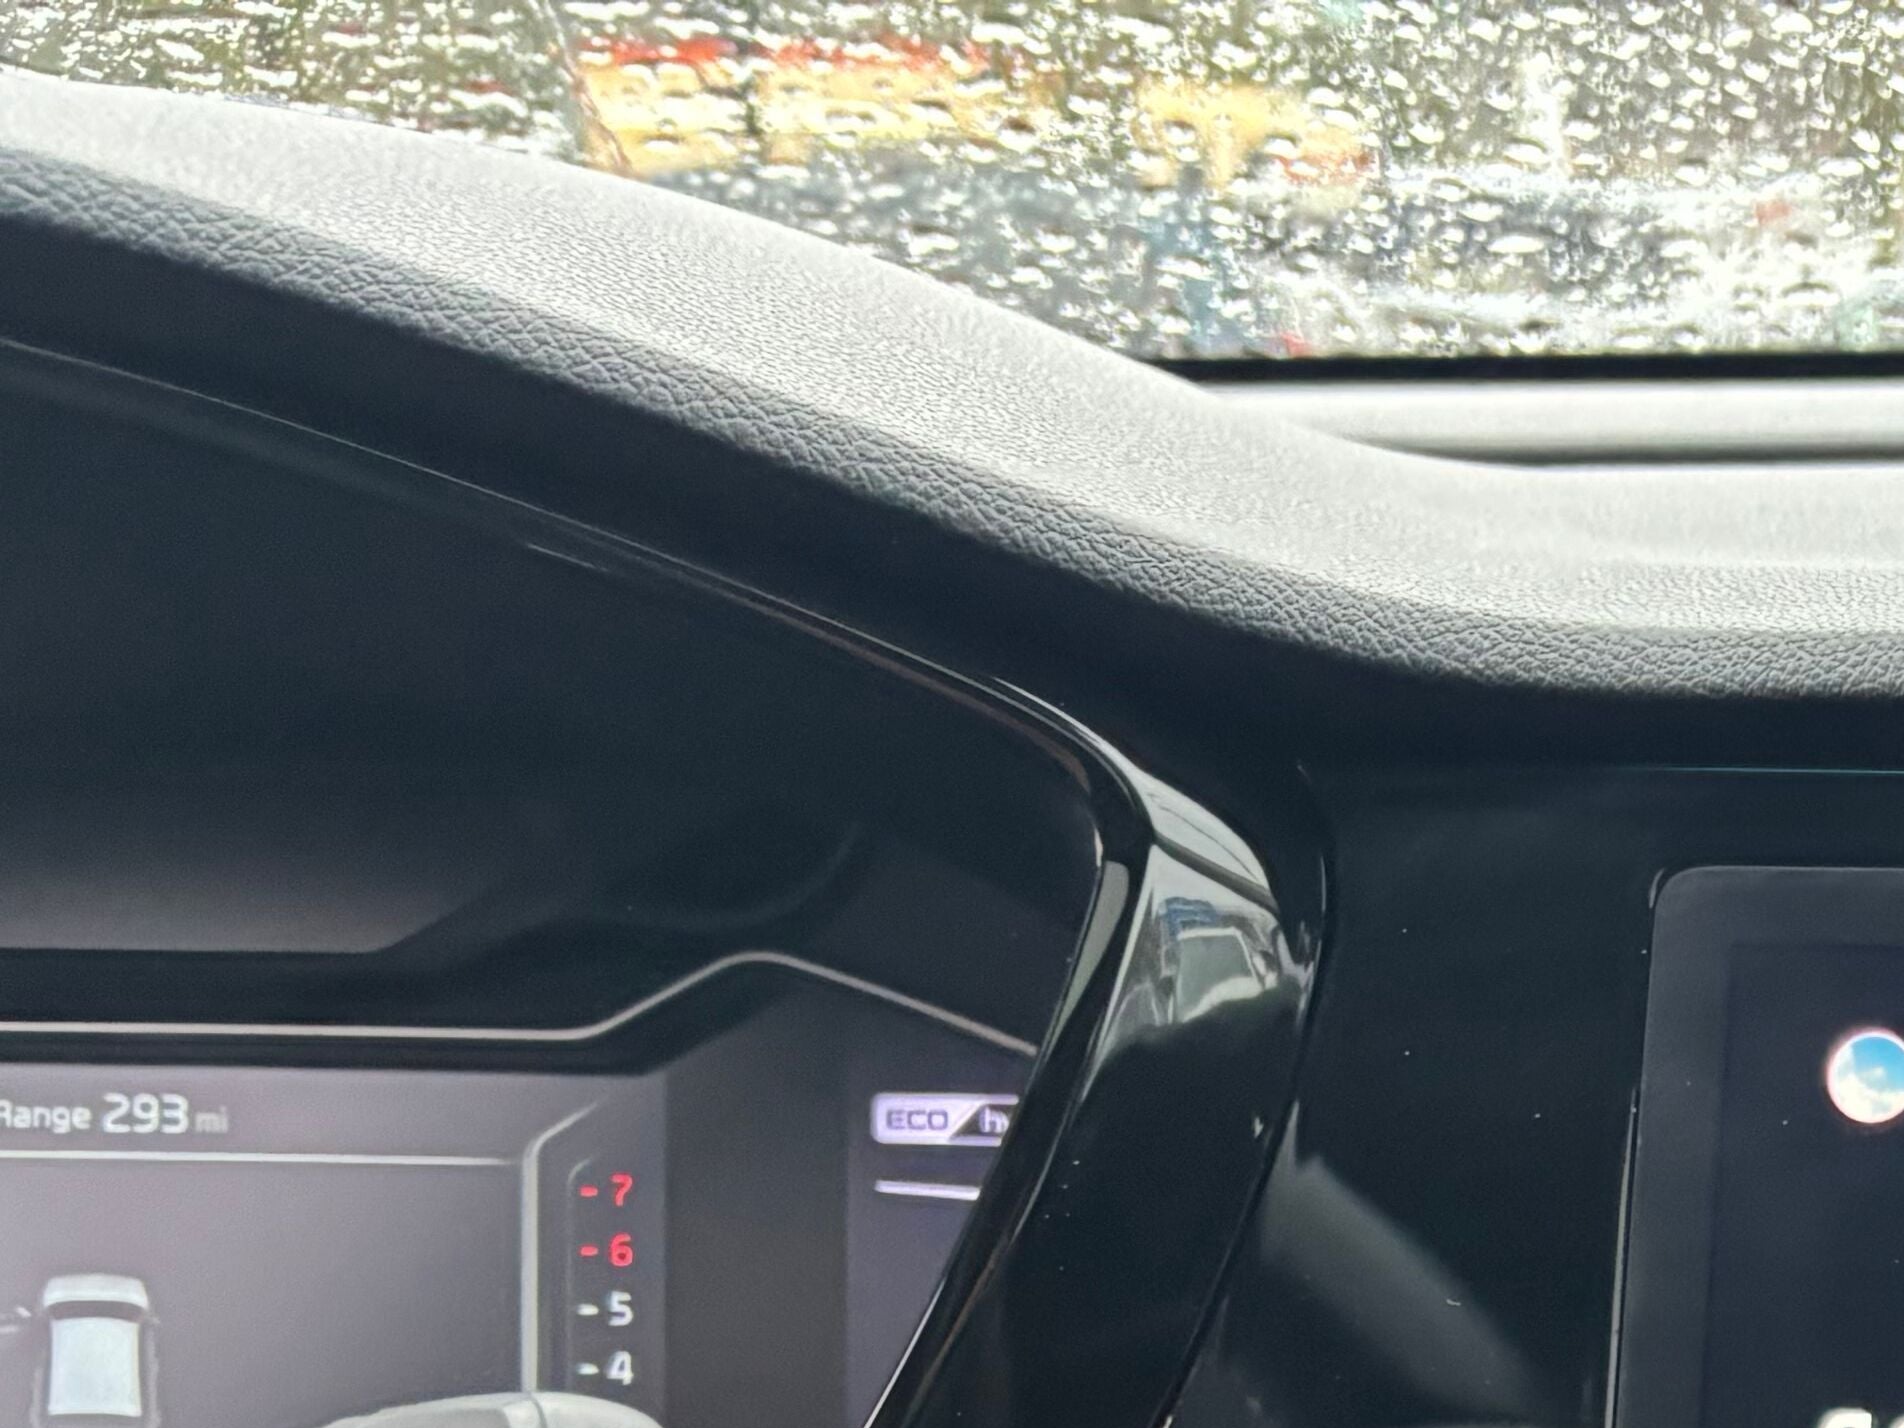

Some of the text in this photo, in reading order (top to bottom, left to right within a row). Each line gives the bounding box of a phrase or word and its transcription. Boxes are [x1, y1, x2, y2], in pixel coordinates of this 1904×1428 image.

[0, 1093, 228, 1134] Range 293 mi
[886, 1108, 948, 1130] ECO
[612, 1174, 632, 1206] 7
[610, 1234, 633, 1266] 6
[610, 1291, 633, 1326] 5
[608, 1352, 633, 1385] 4
